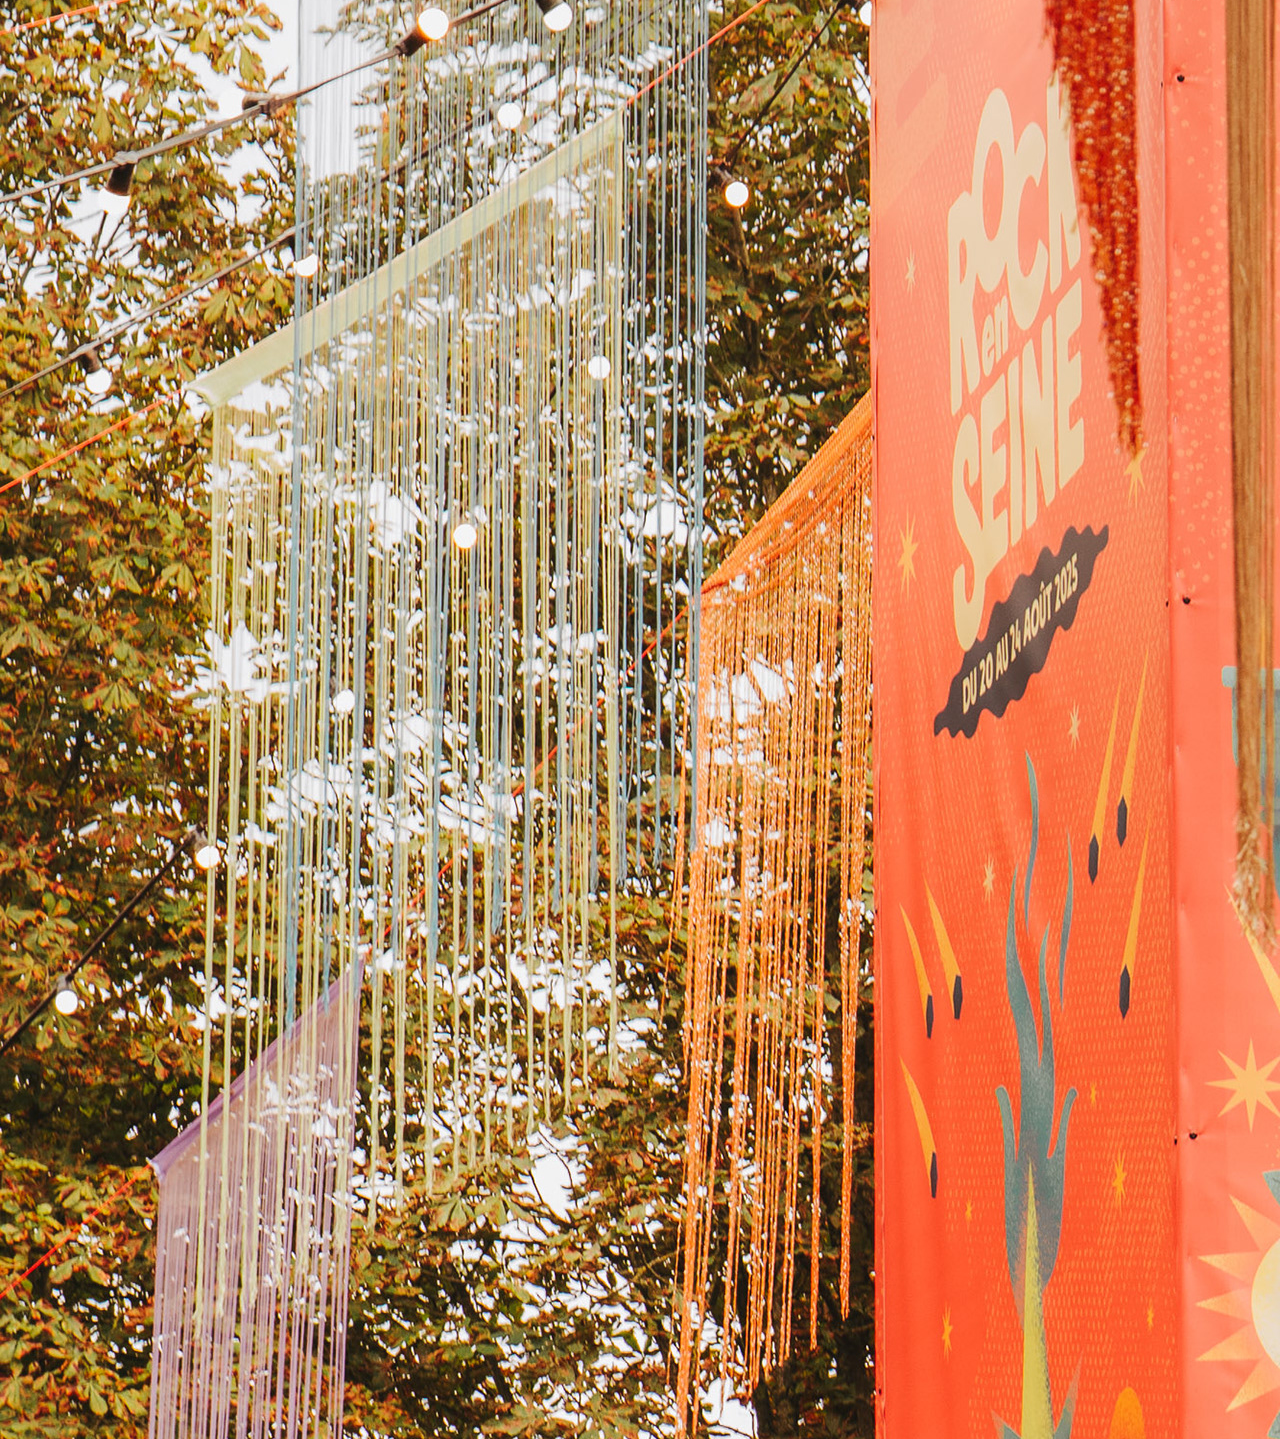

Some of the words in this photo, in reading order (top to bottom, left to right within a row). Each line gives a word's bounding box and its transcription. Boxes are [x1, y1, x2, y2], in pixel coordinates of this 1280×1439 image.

[947, 71, 1081, 416] ROCK
[982, 291, 1009, 379] en
[953, 278, 1085, 652] SEINE
[962, 667, 978, 714] DU
[979, 652, 994, 697] 20
[996, 632, 1009, 681] AU
[1009, 618, 1022, 662] 24
[1023, 580, 1053, 647] AOÛT
[1054, 553, 1079, 613] 2025
